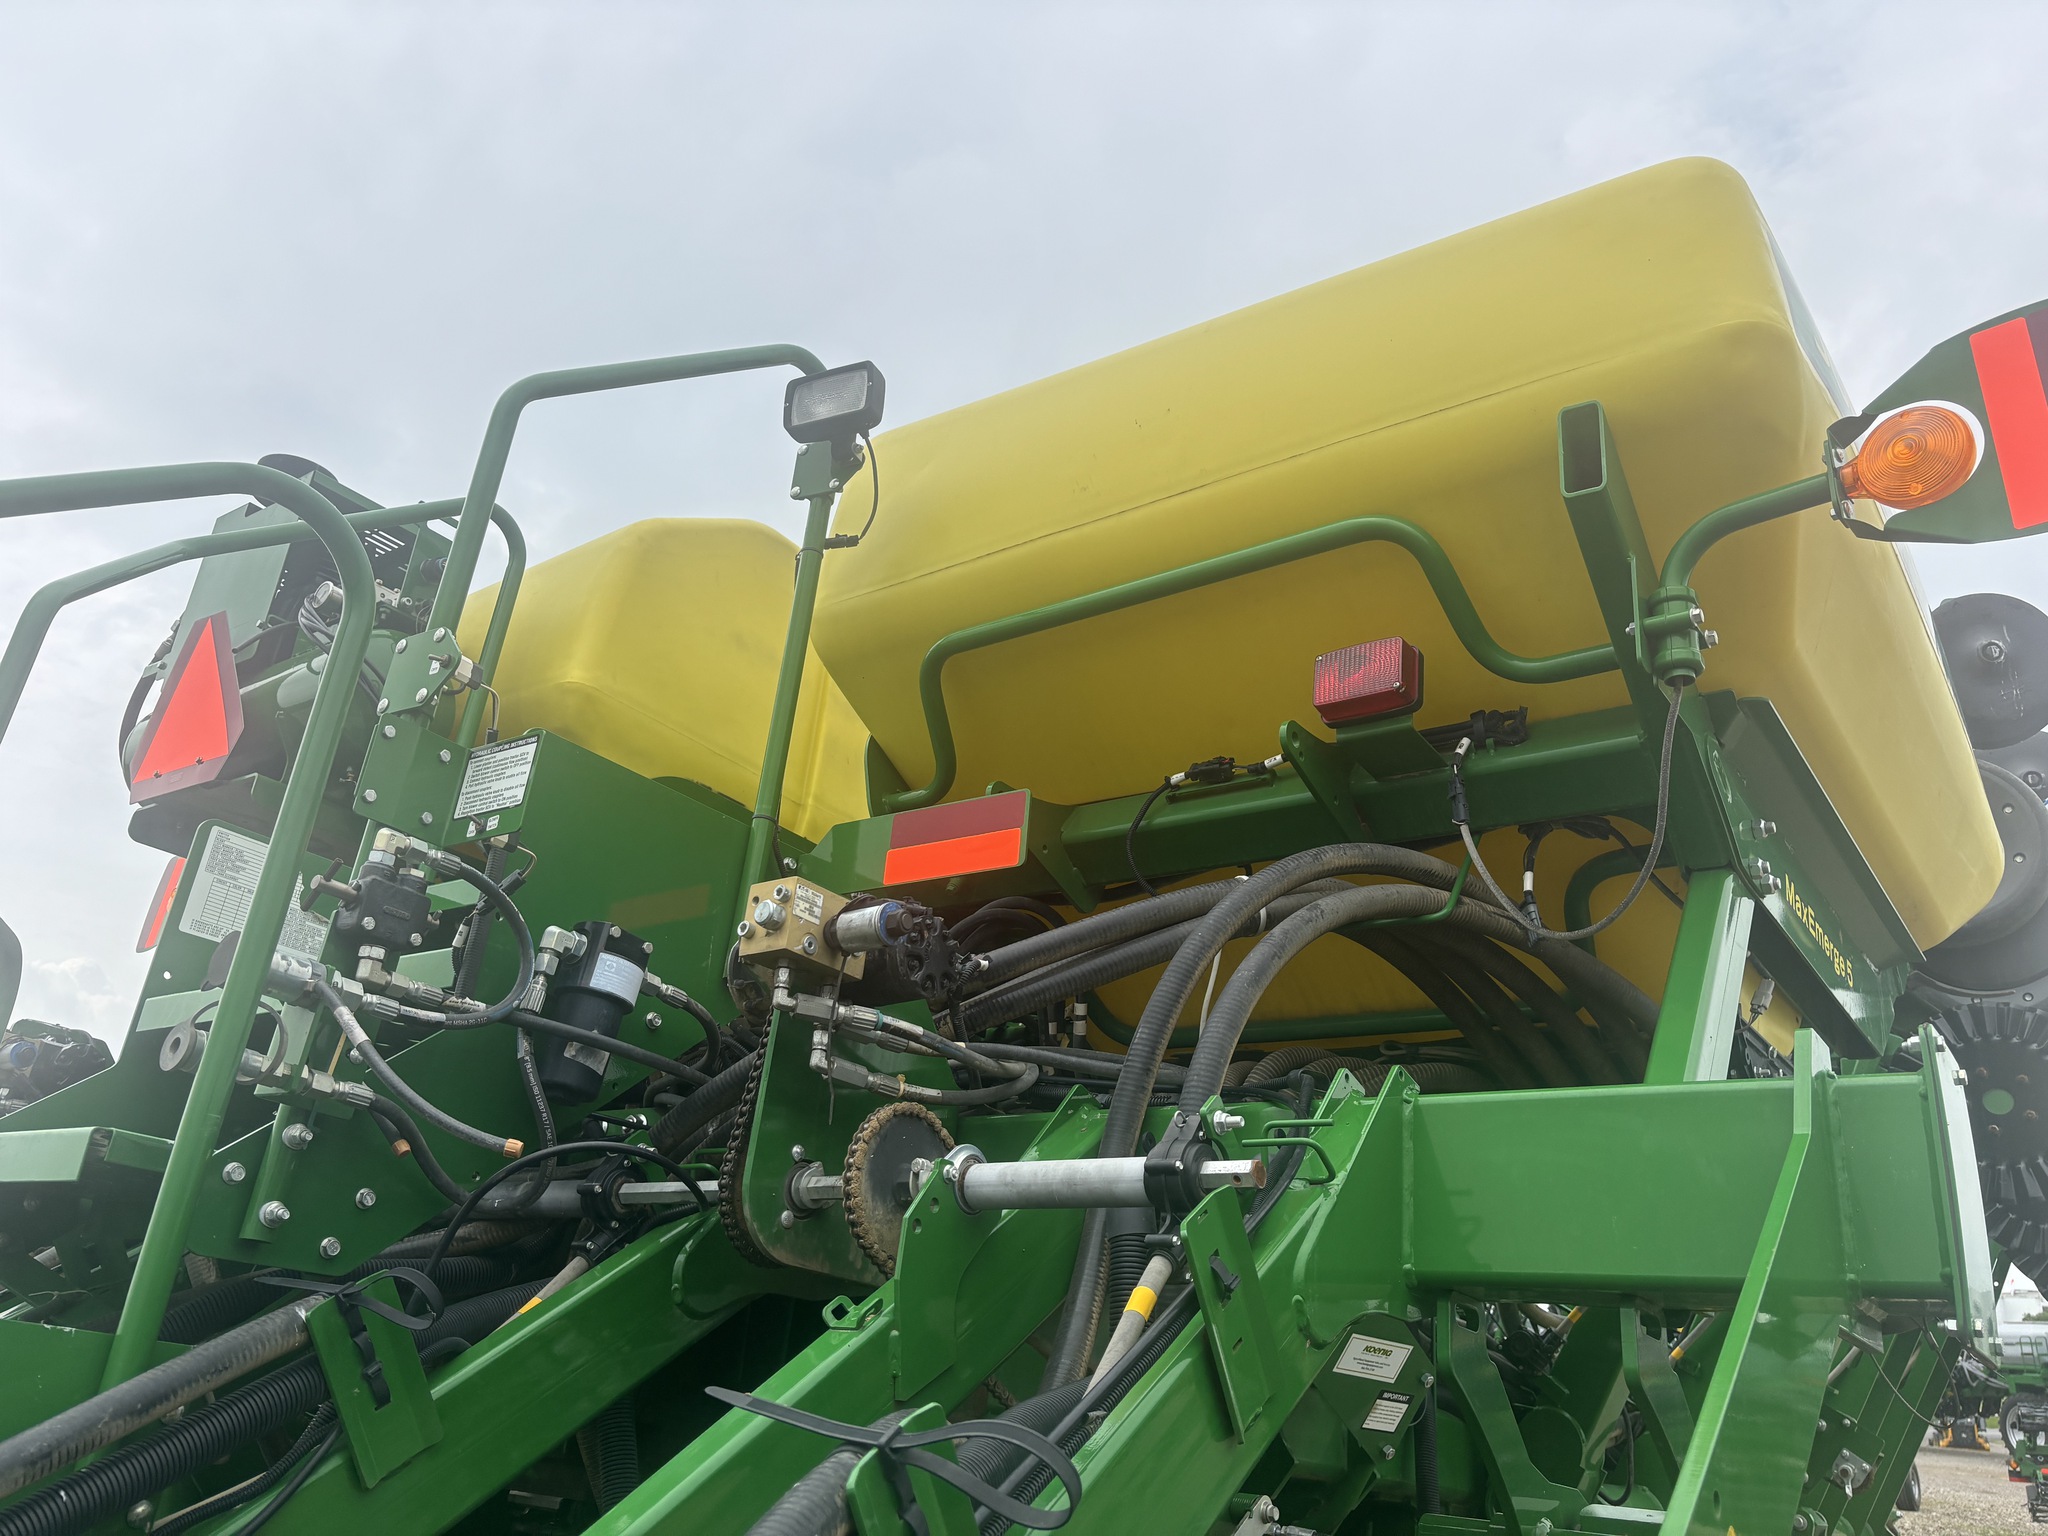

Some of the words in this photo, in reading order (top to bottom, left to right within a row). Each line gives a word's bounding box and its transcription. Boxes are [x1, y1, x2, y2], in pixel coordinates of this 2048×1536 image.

[1785, 874, 1845, 977] MaxEmerge
[1846, 960, 1853, 988] 5
[1382, 1392, 1409, 1402] IMPORTANT
